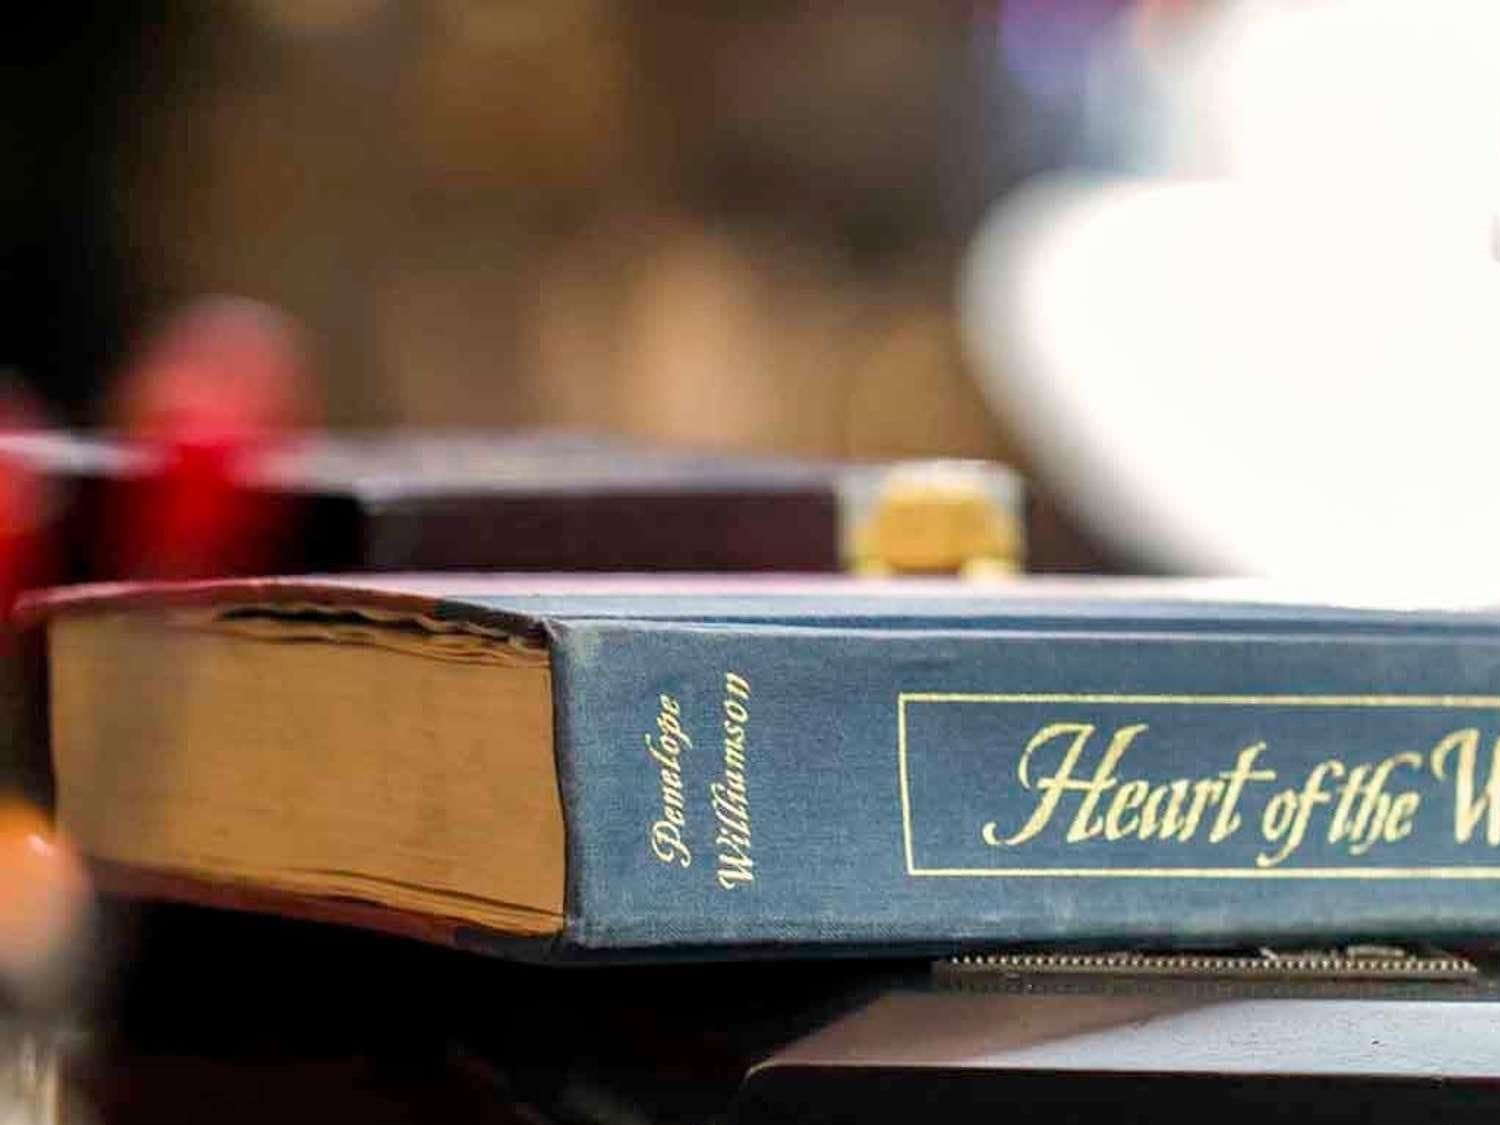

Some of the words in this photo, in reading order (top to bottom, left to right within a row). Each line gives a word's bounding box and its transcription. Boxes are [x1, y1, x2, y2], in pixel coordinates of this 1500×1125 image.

[645, 694, 693, 868] Penelope
[710, 672, 754, 889] Williamson
[982, 722, 1276, 846] Heart
[1256, 760, 1344, 868] of
[1328, 751, 1422, 855] the
